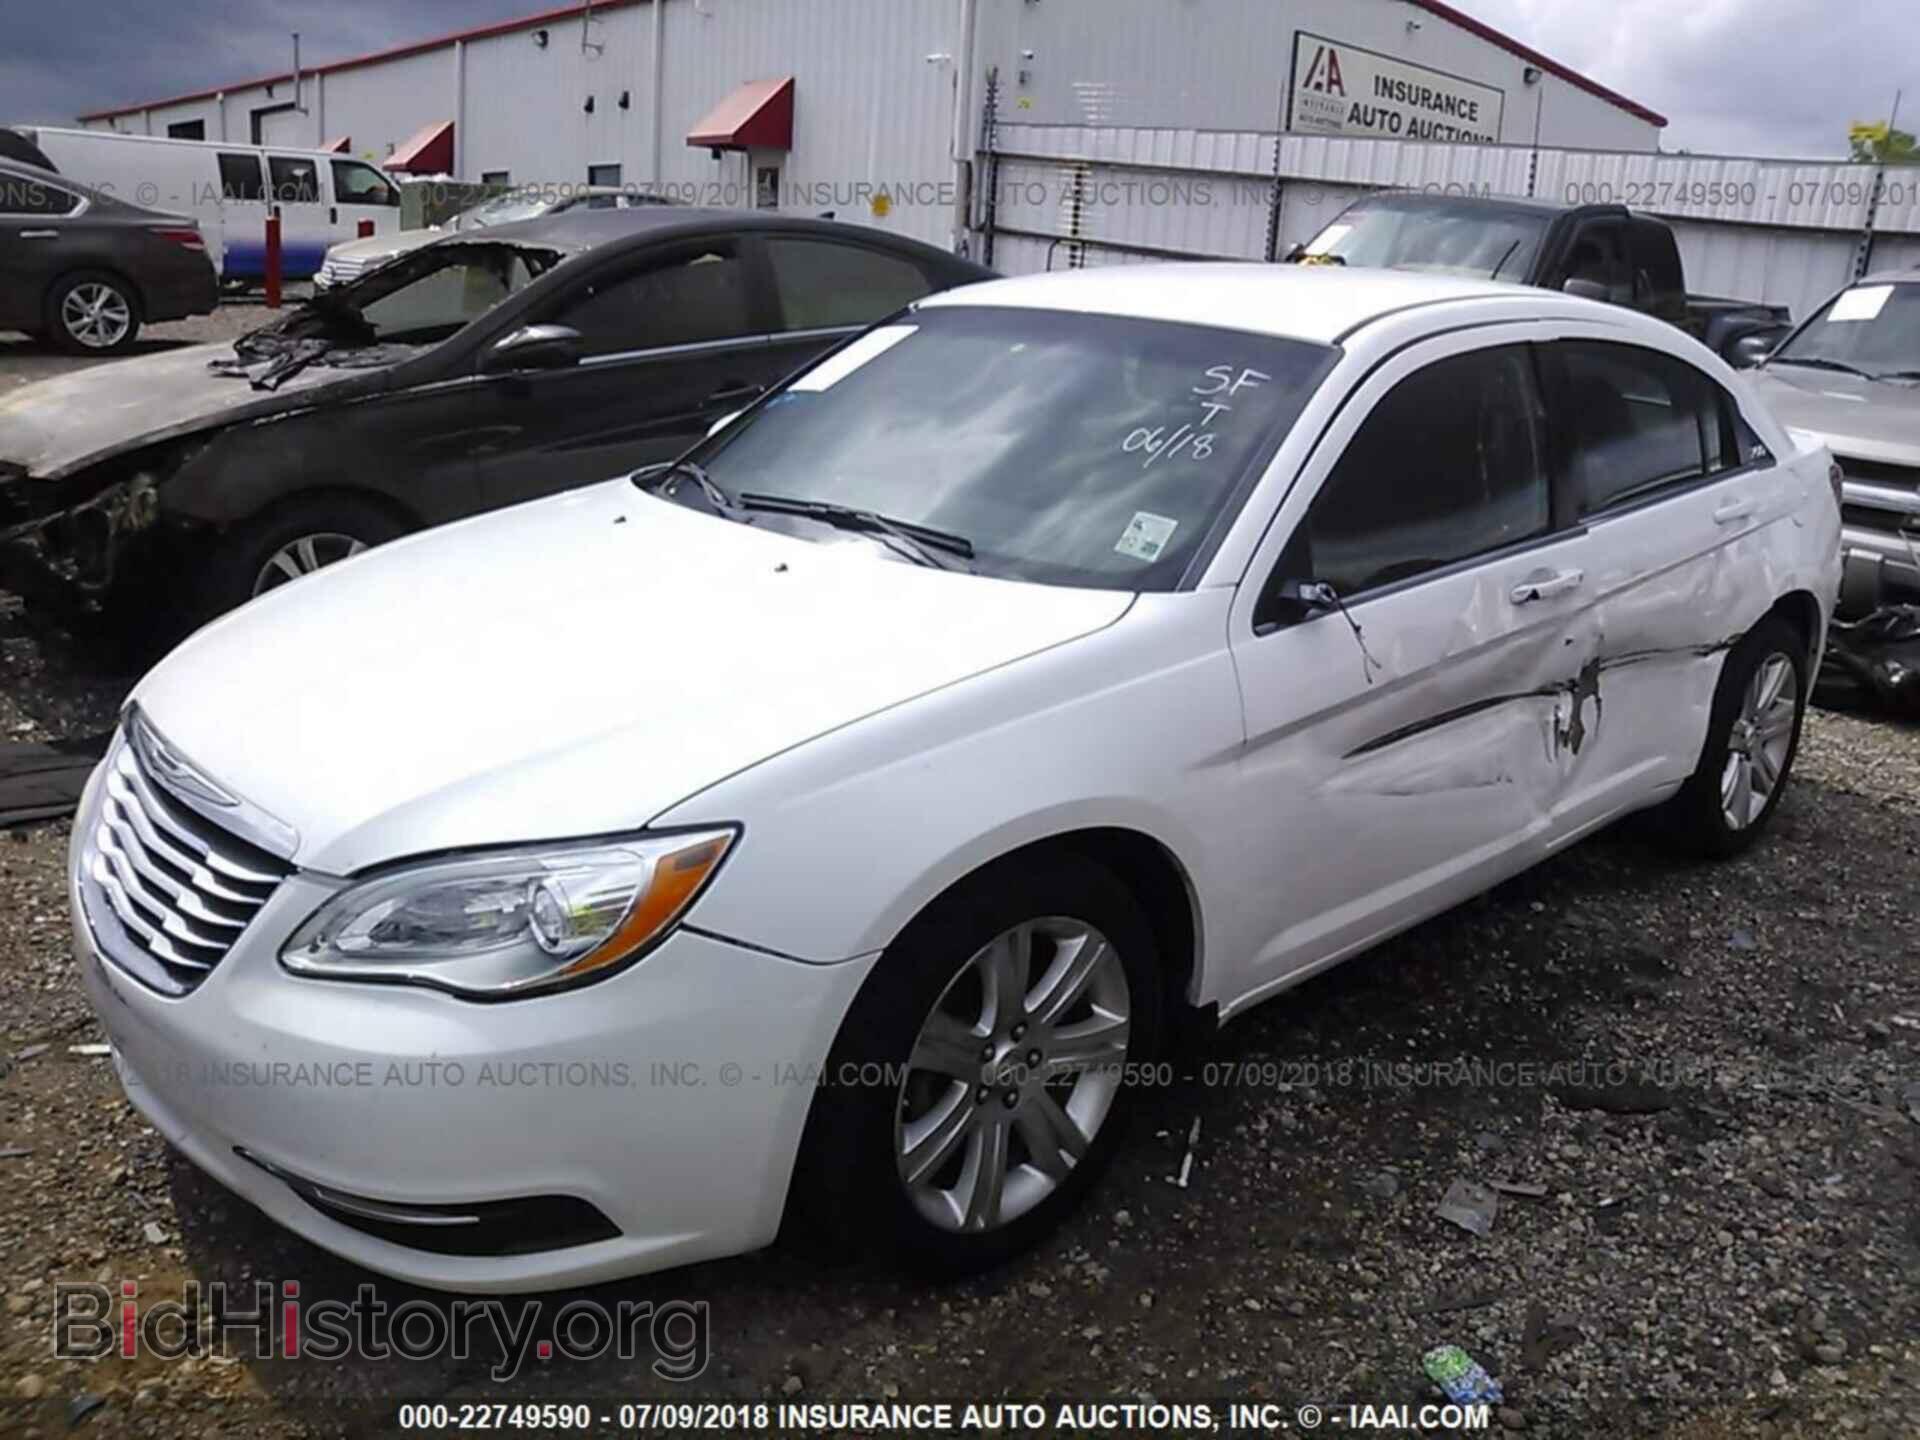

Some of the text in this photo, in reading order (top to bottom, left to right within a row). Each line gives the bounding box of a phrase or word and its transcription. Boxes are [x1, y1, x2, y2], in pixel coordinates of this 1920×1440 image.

[1374, 75, 1479, 122] INSURANCE
[1347, 102, 1402, 133] AUTO
[1192, 365, 1272, 396] SF
[1201, 402, 1231, 426] T
